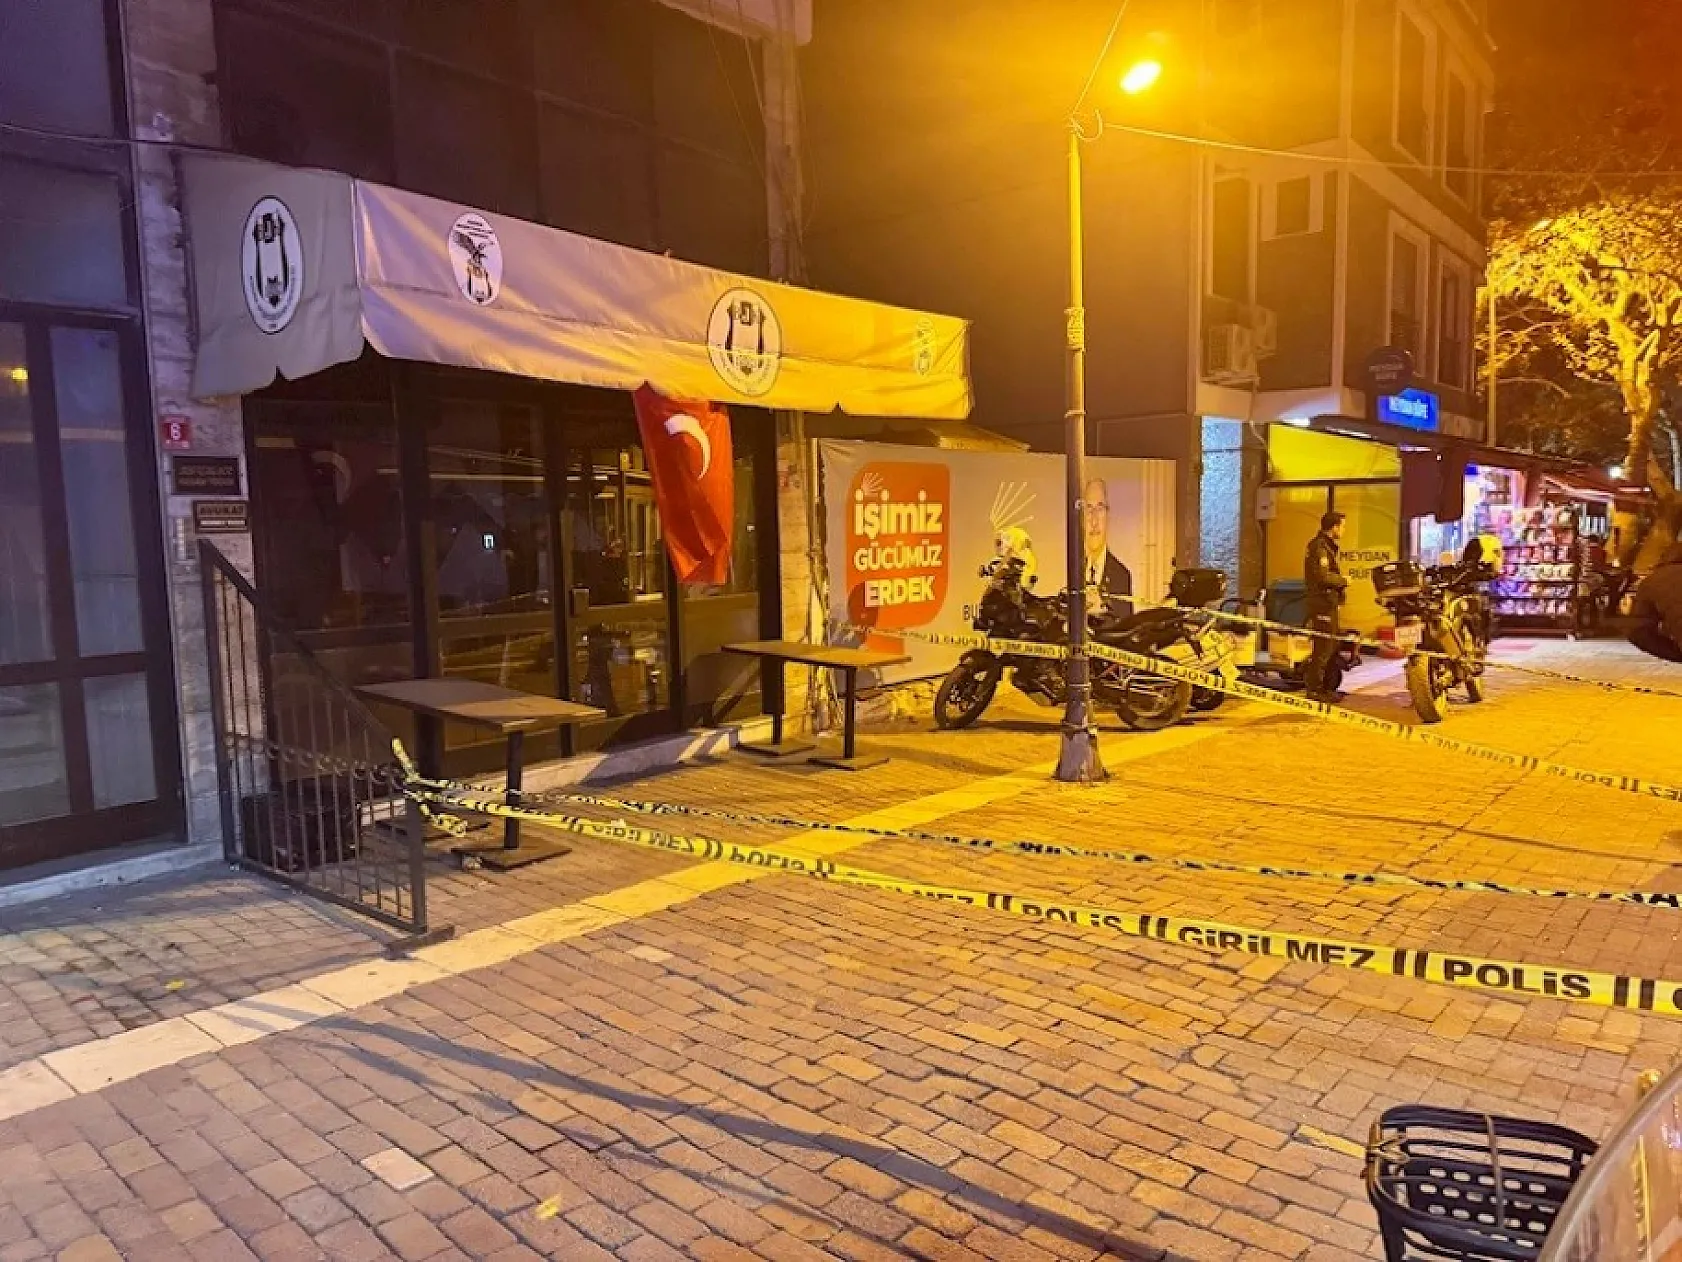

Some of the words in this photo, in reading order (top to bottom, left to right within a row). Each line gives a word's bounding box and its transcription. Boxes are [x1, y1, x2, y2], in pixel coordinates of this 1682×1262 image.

[854, 488, 943, 540] işimiz
[854, 538, 943, 571] GÜCÜMÜZ
[1340, 551, 1390, 561] MEYDAN
[865, 575, 936, 608] ERDEK
